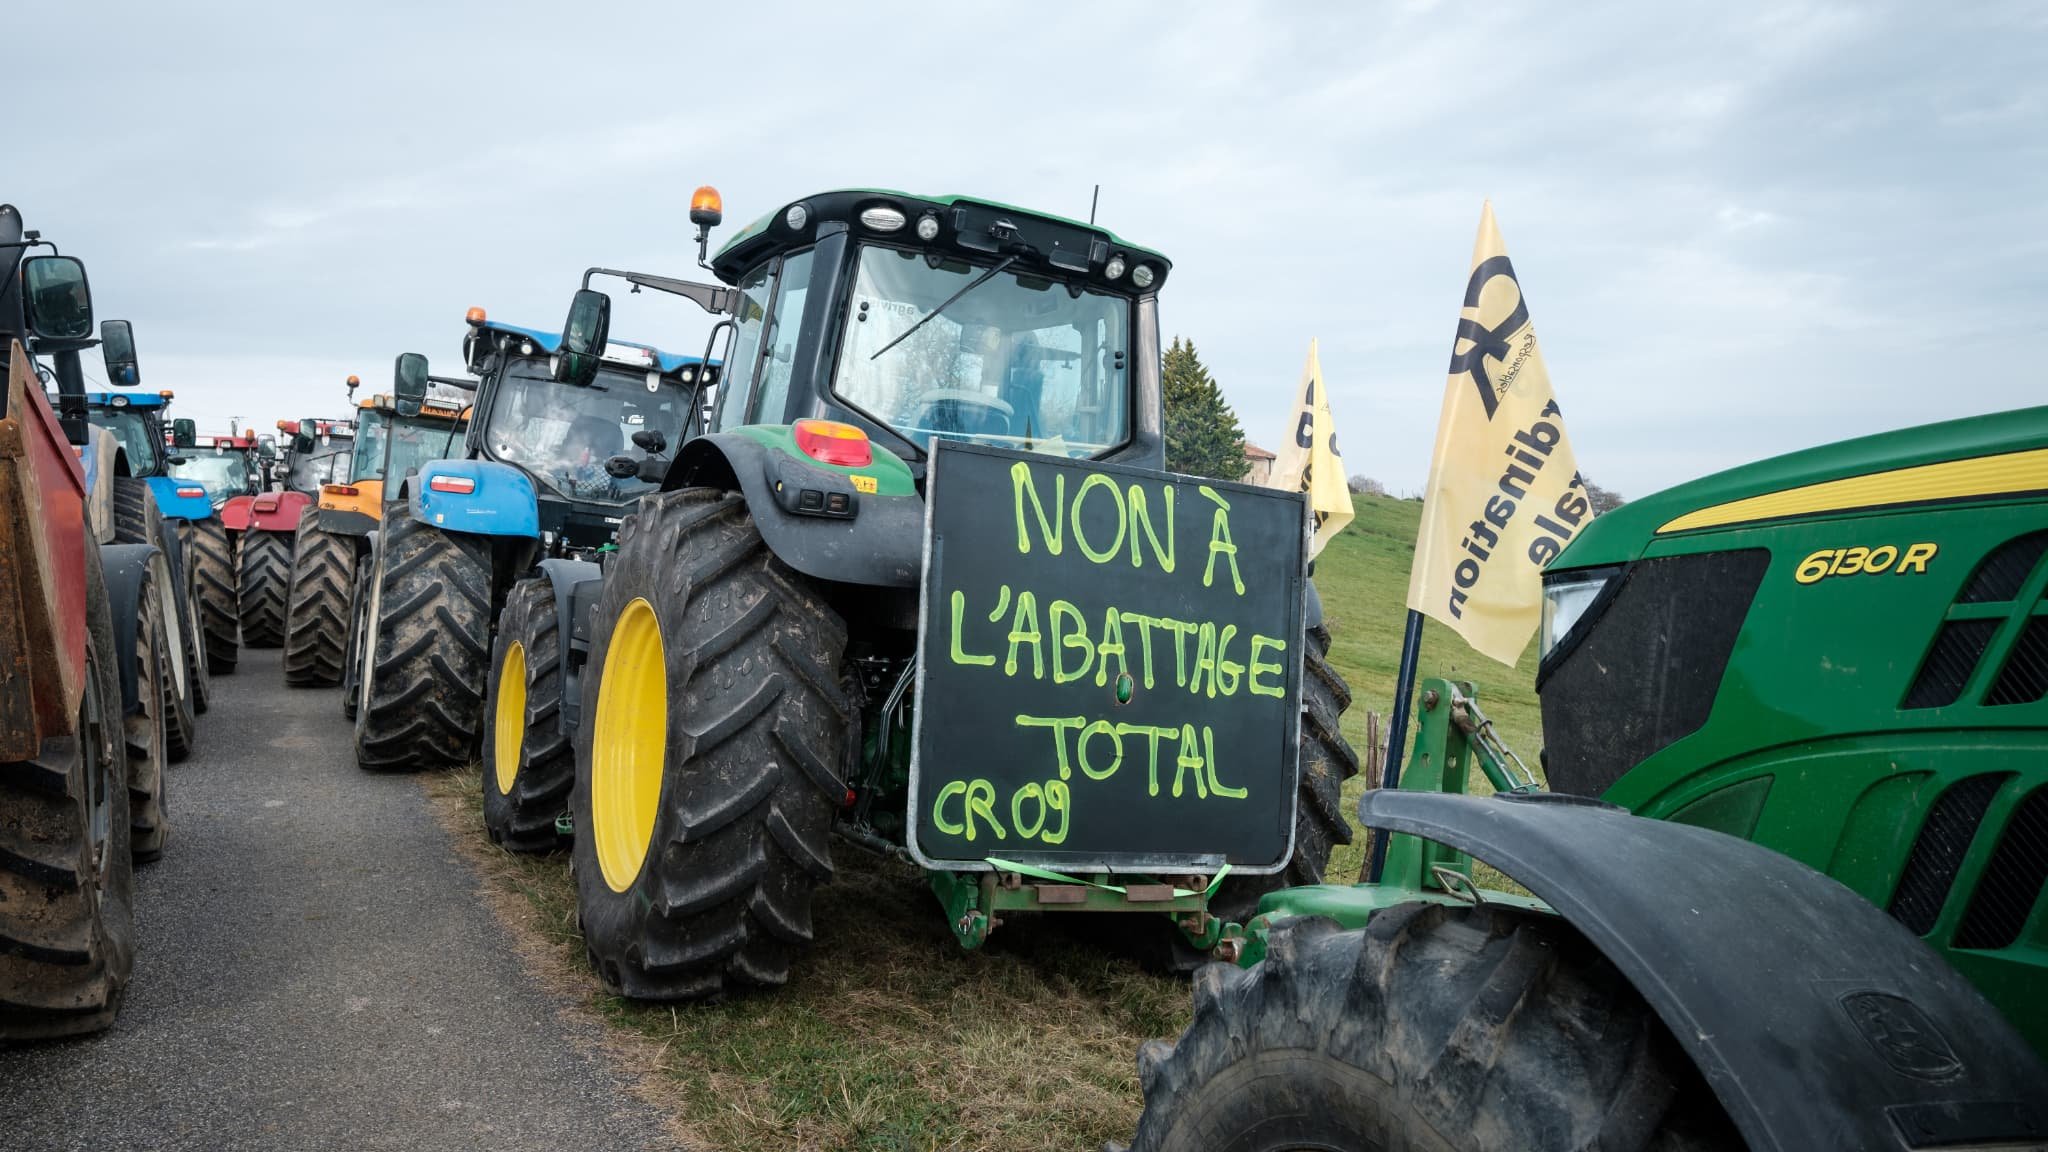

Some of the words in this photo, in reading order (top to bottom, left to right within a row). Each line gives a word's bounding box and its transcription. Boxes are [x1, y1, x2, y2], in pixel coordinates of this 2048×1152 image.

[1011, 462, 1174, 573] NON
[1199, 486, 1246, 595] À
[950, 585, 1286, 699] L'ABATTAGE
[1015, 714, 1249, 799] TOTAL
